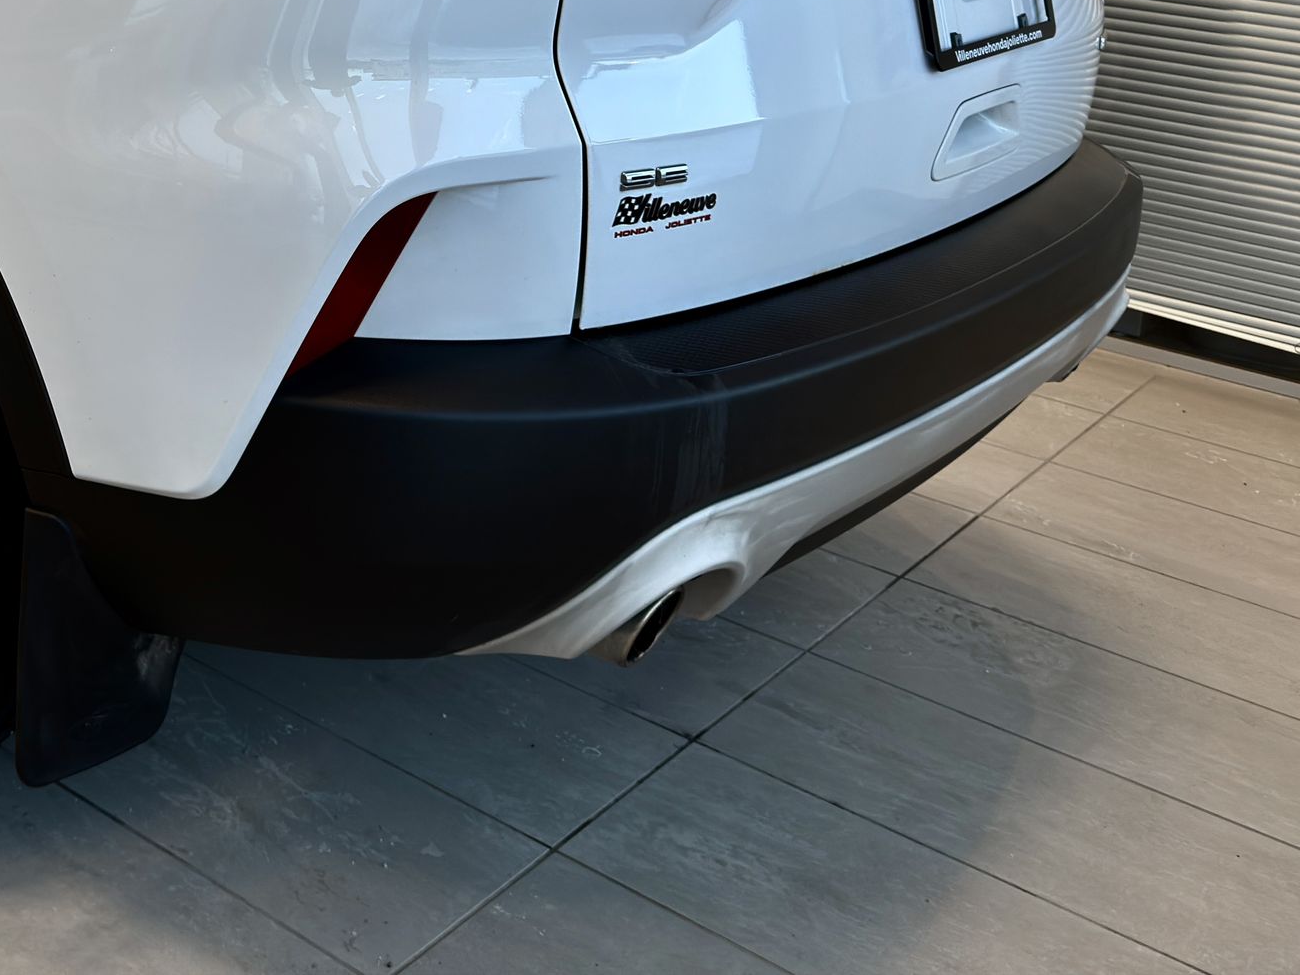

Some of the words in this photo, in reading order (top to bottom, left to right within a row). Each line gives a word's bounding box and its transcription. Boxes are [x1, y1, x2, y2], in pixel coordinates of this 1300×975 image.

[619, 163, 689, 192] SE
[614, 226, 654, 238] HONDA
[665, 214, 712, 229] JOLIETTE
